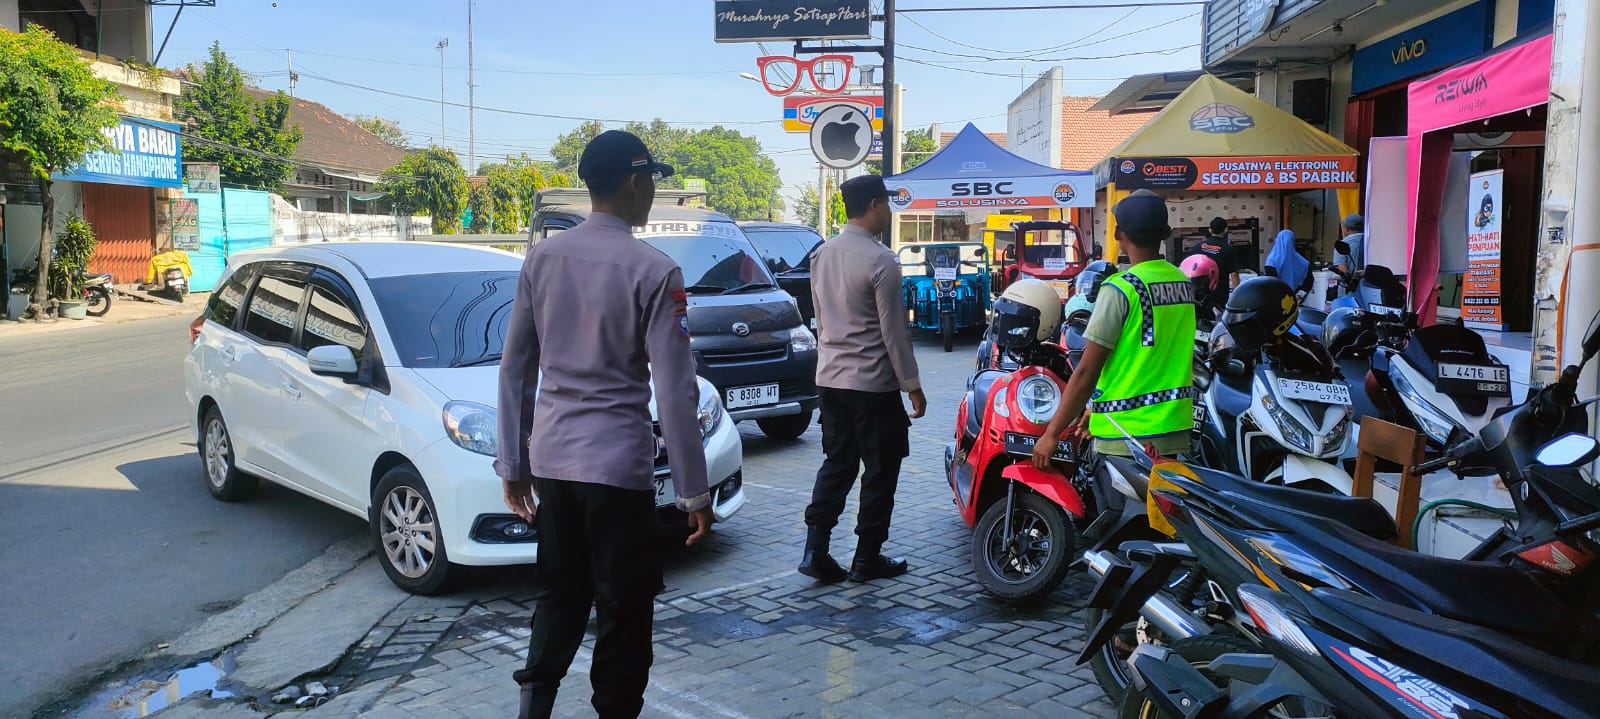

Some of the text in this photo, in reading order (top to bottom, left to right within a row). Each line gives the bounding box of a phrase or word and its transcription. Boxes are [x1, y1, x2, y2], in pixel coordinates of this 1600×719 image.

[718, 8, 790, 29] Murahnya
[1193, 117, 1250, 129] SBC
[138, 126, 177, 156] BARU
[86, 149, 121, 176] SERVIS
[123, 153, 178, 180] HANDPHONE
[1218, 161, 1339, 171] PUSATNYA ELEKTRONIK
[1202, 171, 1356, 184] SECOND & BS PABRIK
[951, 182, 1014, 196] SBC
[1054, 190, 1075, 199] SBC
[936, 198, 1029, 207] SOLUSINYA
[632, 223, 737, 236] UTRA JAYA
[1468, 232, 1500, 242] HATI-HATI
[1468, 242, 1500, 252] PENIPUAN
[1441, 366, 1506, 380] L 4476 IE
[1281, 379, 1288, 388] S
[1294, 381, 1321, 392] 2584
[728, 390, 735, 402] S
[740, 387, 761, 401] 8308
[767, 385, 778, 397] WT
